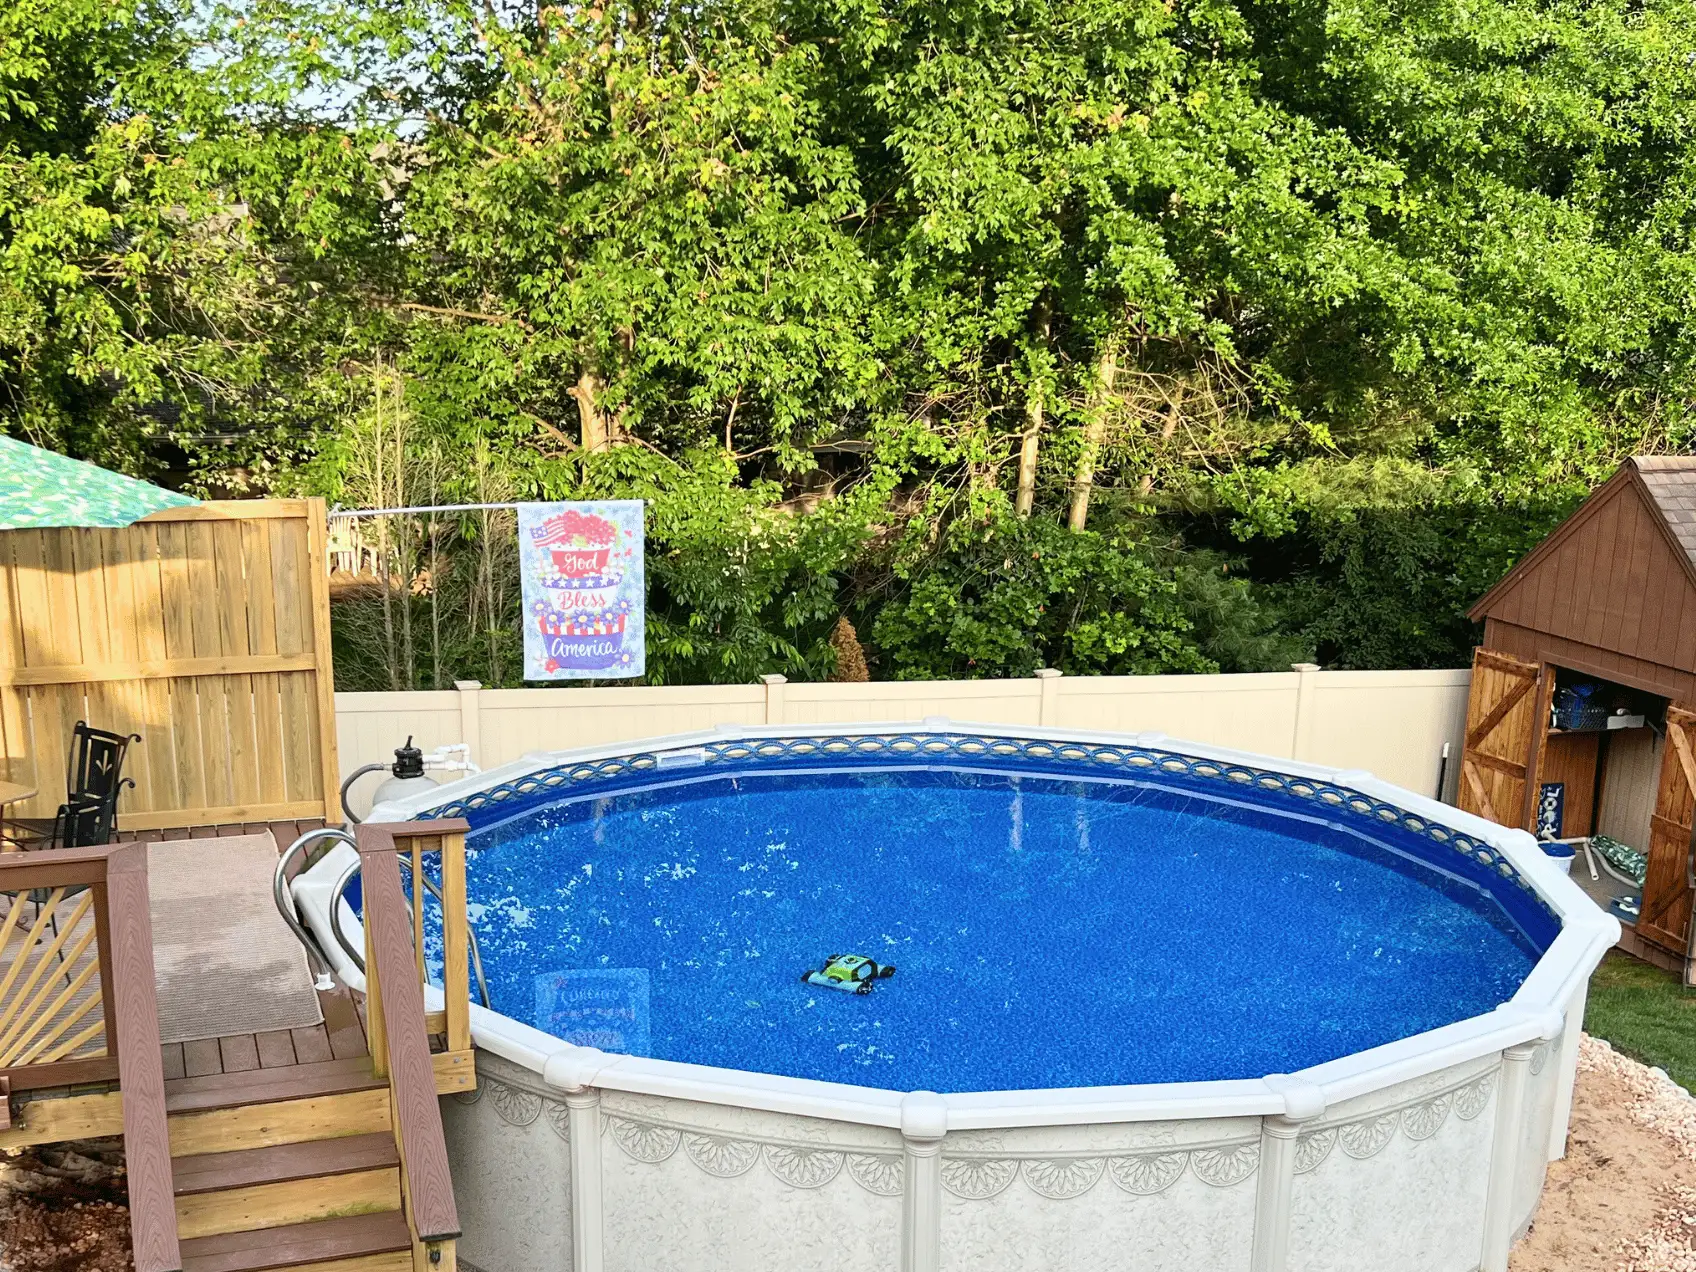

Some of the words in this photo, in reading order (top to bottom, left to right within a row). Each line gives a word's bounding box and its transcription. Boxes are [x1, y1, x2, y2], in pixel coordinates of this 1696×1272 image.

[564, 553, 599, 573] God
[558, 591, 606, 610] Bless
[551, 637, 617, 657] America
